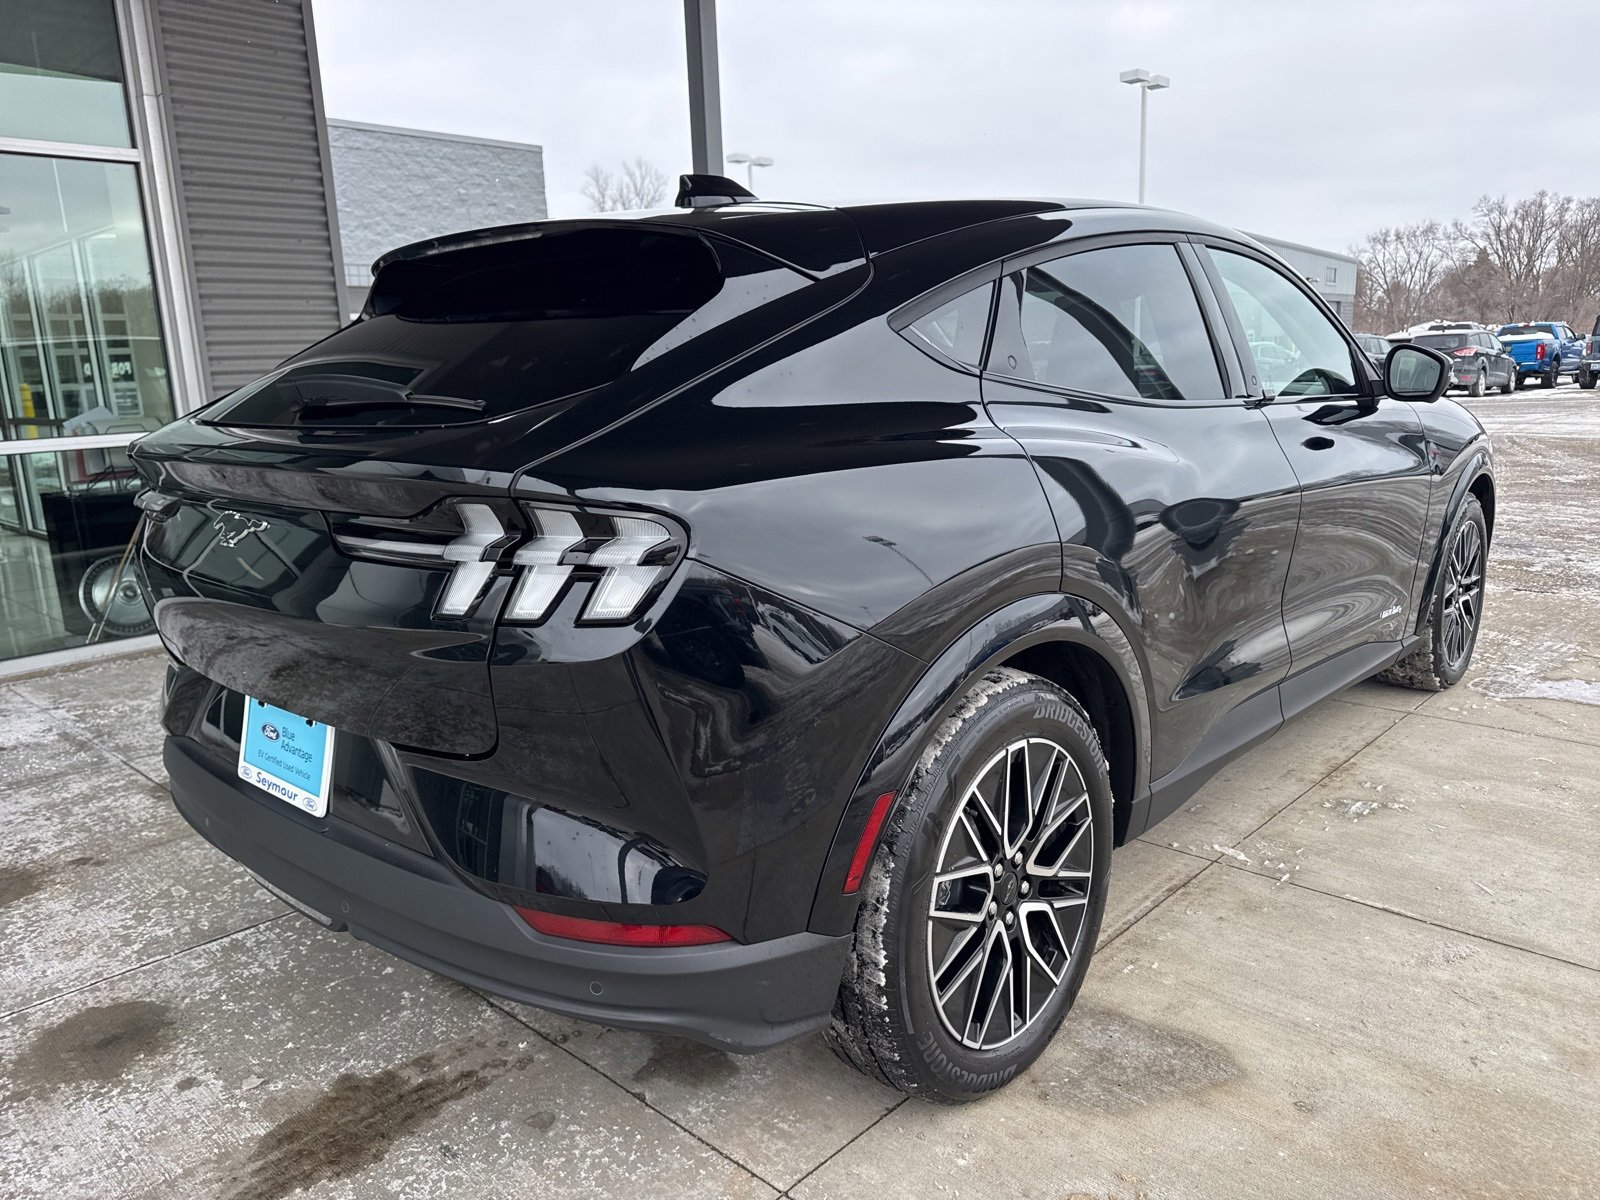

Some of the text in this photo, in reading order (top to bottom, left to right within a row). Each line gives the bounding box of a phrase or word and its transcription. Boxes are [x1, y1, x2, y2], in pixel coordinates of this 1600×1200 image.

[263, 723, 278, 741] Ford
[282, 727, 295, 742] Blue
[1033, 699, 1107, 779] BRIDGESTONE
[258, 749, 311, 781] EV Certified Used Vehicle
[281, 740, 313, 763] Advantage
[256, 771, 298, 801] Seymour
[916, 1031, 1017, 1093] BRIDGESTONE
